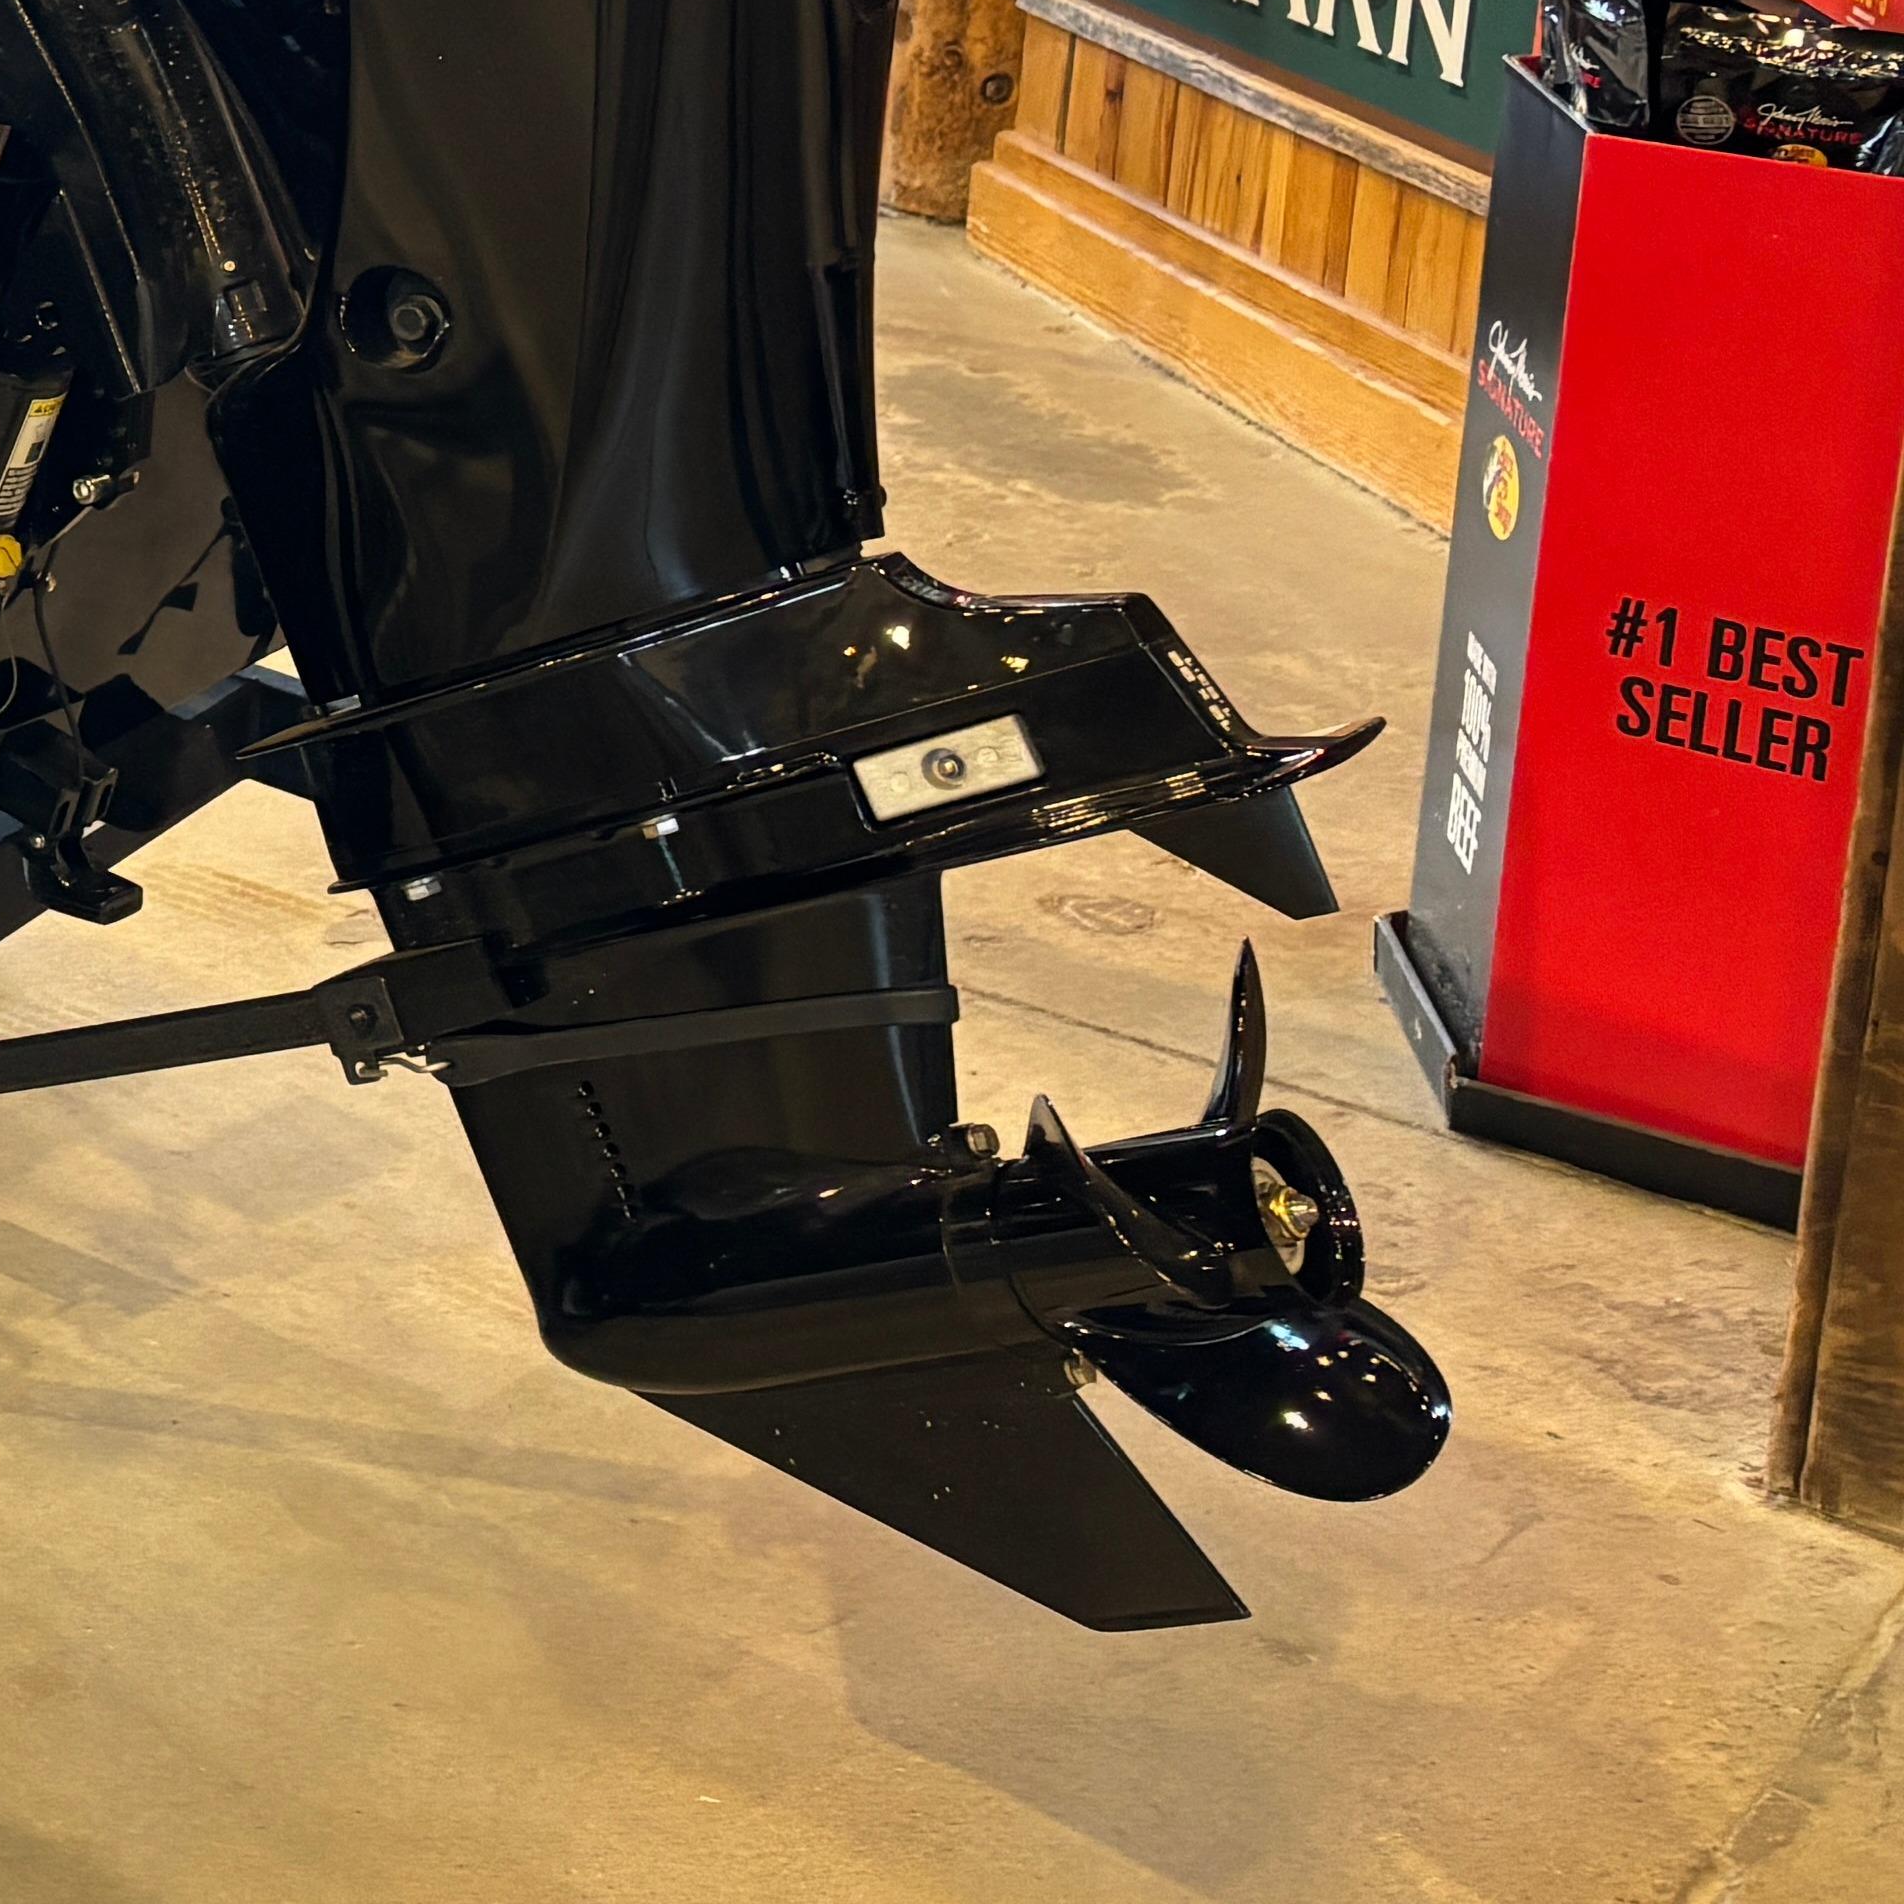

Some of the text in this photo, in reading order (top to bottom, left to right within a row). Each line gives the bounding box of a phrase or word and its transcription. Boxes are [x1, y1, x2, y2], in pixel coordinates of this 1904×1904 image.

[1606, 595, 1864, 708] #1 BEST
[1615, 675, 1832, 783] SELLER
[1446, 771, 1483, 876] BEEF
